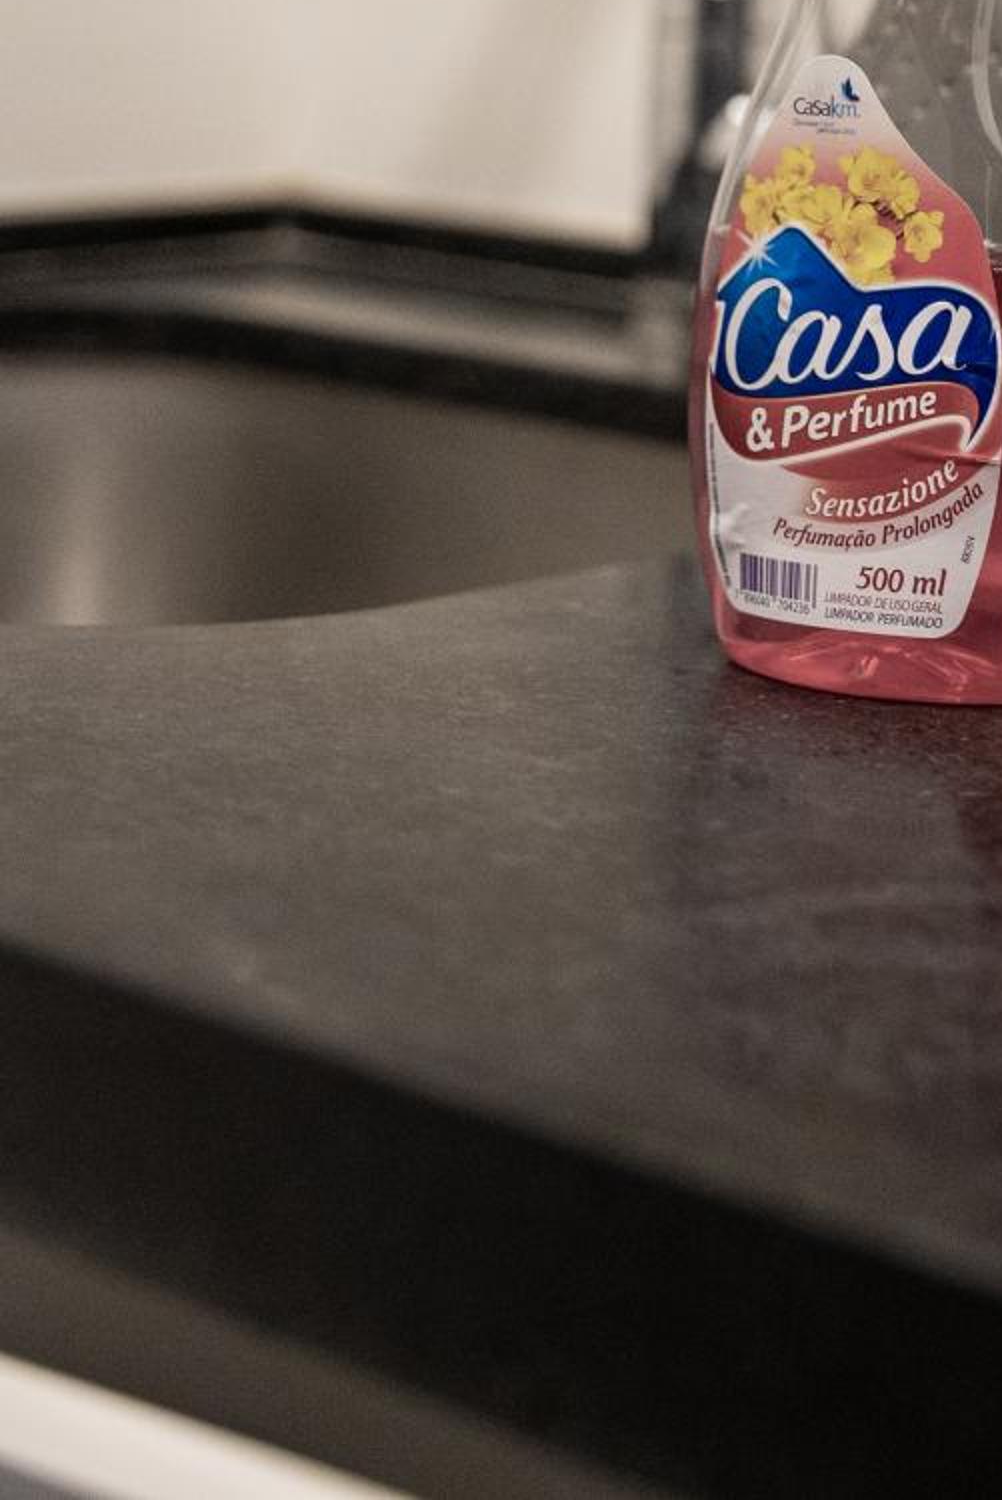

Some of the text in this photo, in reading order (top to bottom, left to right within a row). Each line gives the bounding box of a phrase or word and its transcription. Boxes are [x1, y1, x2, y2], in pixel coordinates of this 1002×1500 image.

[725, 277, 972, 391] Casa
[746, 390, 937, 452] & Perfume
[773, 481, 985, 552] Perfumação Prolongada
[806, 459, 960, 518] Sensazione
[855, 566, 947, 596] 500 ml
[911, 600, 943, 615] GERAL
[876, 613, 944, 630] PERFUMADO
